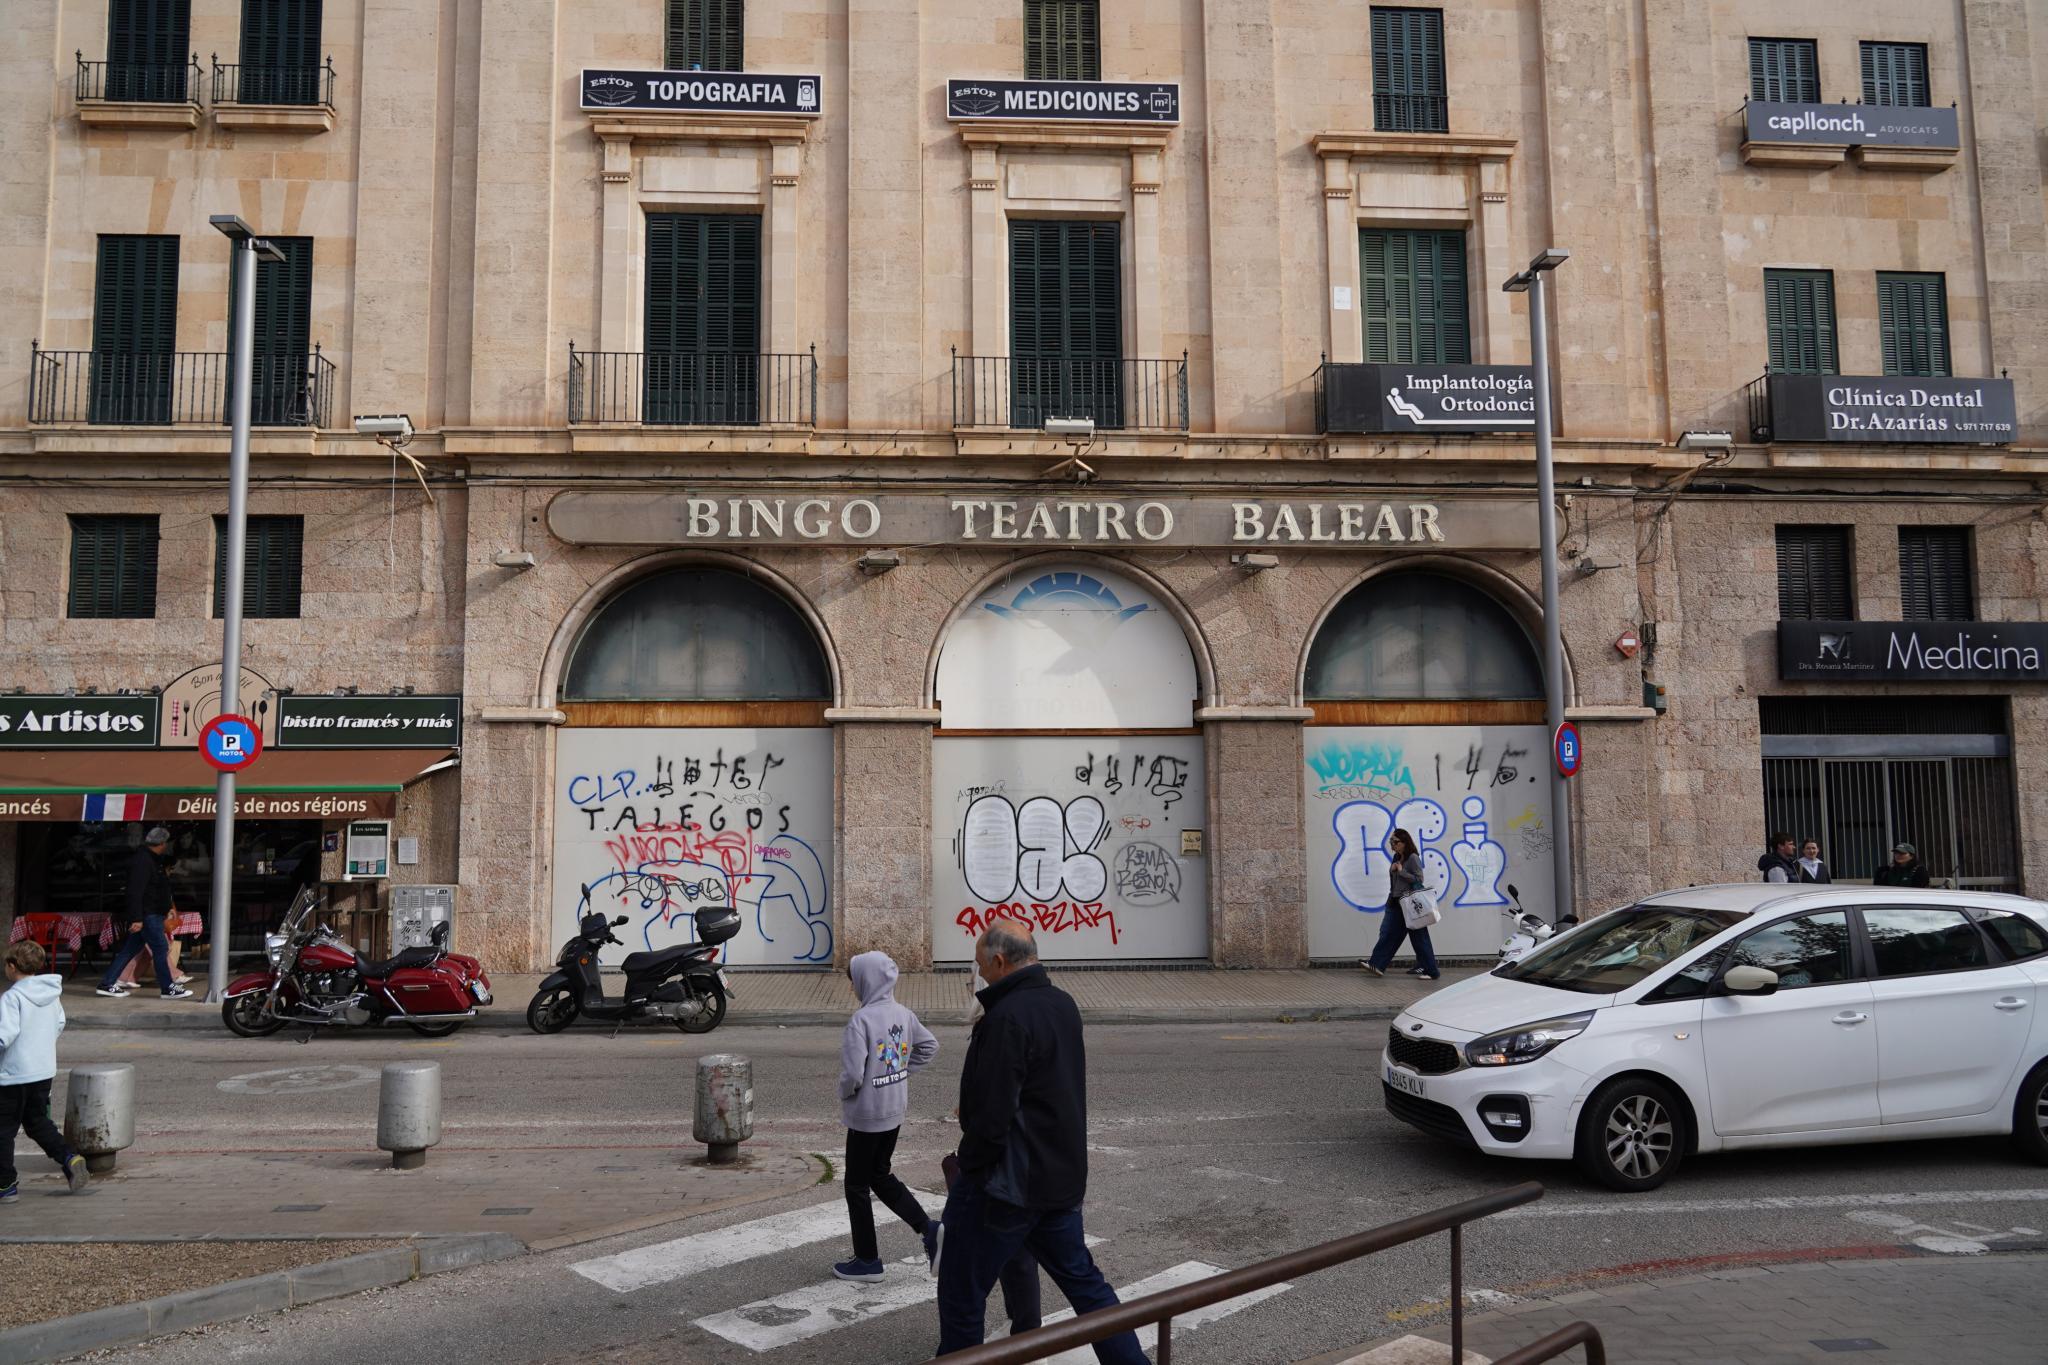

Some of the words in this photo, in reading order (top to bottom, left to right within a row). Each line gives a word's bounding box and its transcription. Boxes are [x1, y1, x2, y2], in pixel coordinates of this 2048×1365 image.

[590, 77, 634, 88] ESTOP
[646, 80, 786, 103] TOPOGRAFIA
[954, 87, 997, 98] ESTOP
[1004, 90, 1140, 112] MEDICIONES
[1879, 125, 1939, 135] ADVOCATS
[1405, 374, 1533, 394] Implantología
[1440, 396, 1536, 412] Ortodonci
[1828, 387, 1906, 407] Clínica
[1909, 389, 1984, 408] Dental
[1962, 423, 1978, 431] 971
[1979, 423, 1993, 431] 717
[686, 499, 881, 539] BINGO
[951, 501, 1175, 541] TEATRO
[1231, 503, 1446, 542] BALEAR
[1886, 631, 2040, 670] Medicina
[17, 710, 145, 732] Artistes
[282, 715, 334, 729] bistro
[336, 713, 400, 729] francés
[400, 717, 415, 730] y
[415, 713, 454, 729] más
[226, 736, 236, 748] P
[177, 797, 239, 814] Délis
[243, 797, 265, 814] de
[269, 801, 300, 814] nos
[304, 796, 367, 816] régions
[872, 1076, 890, 1086] TIME
